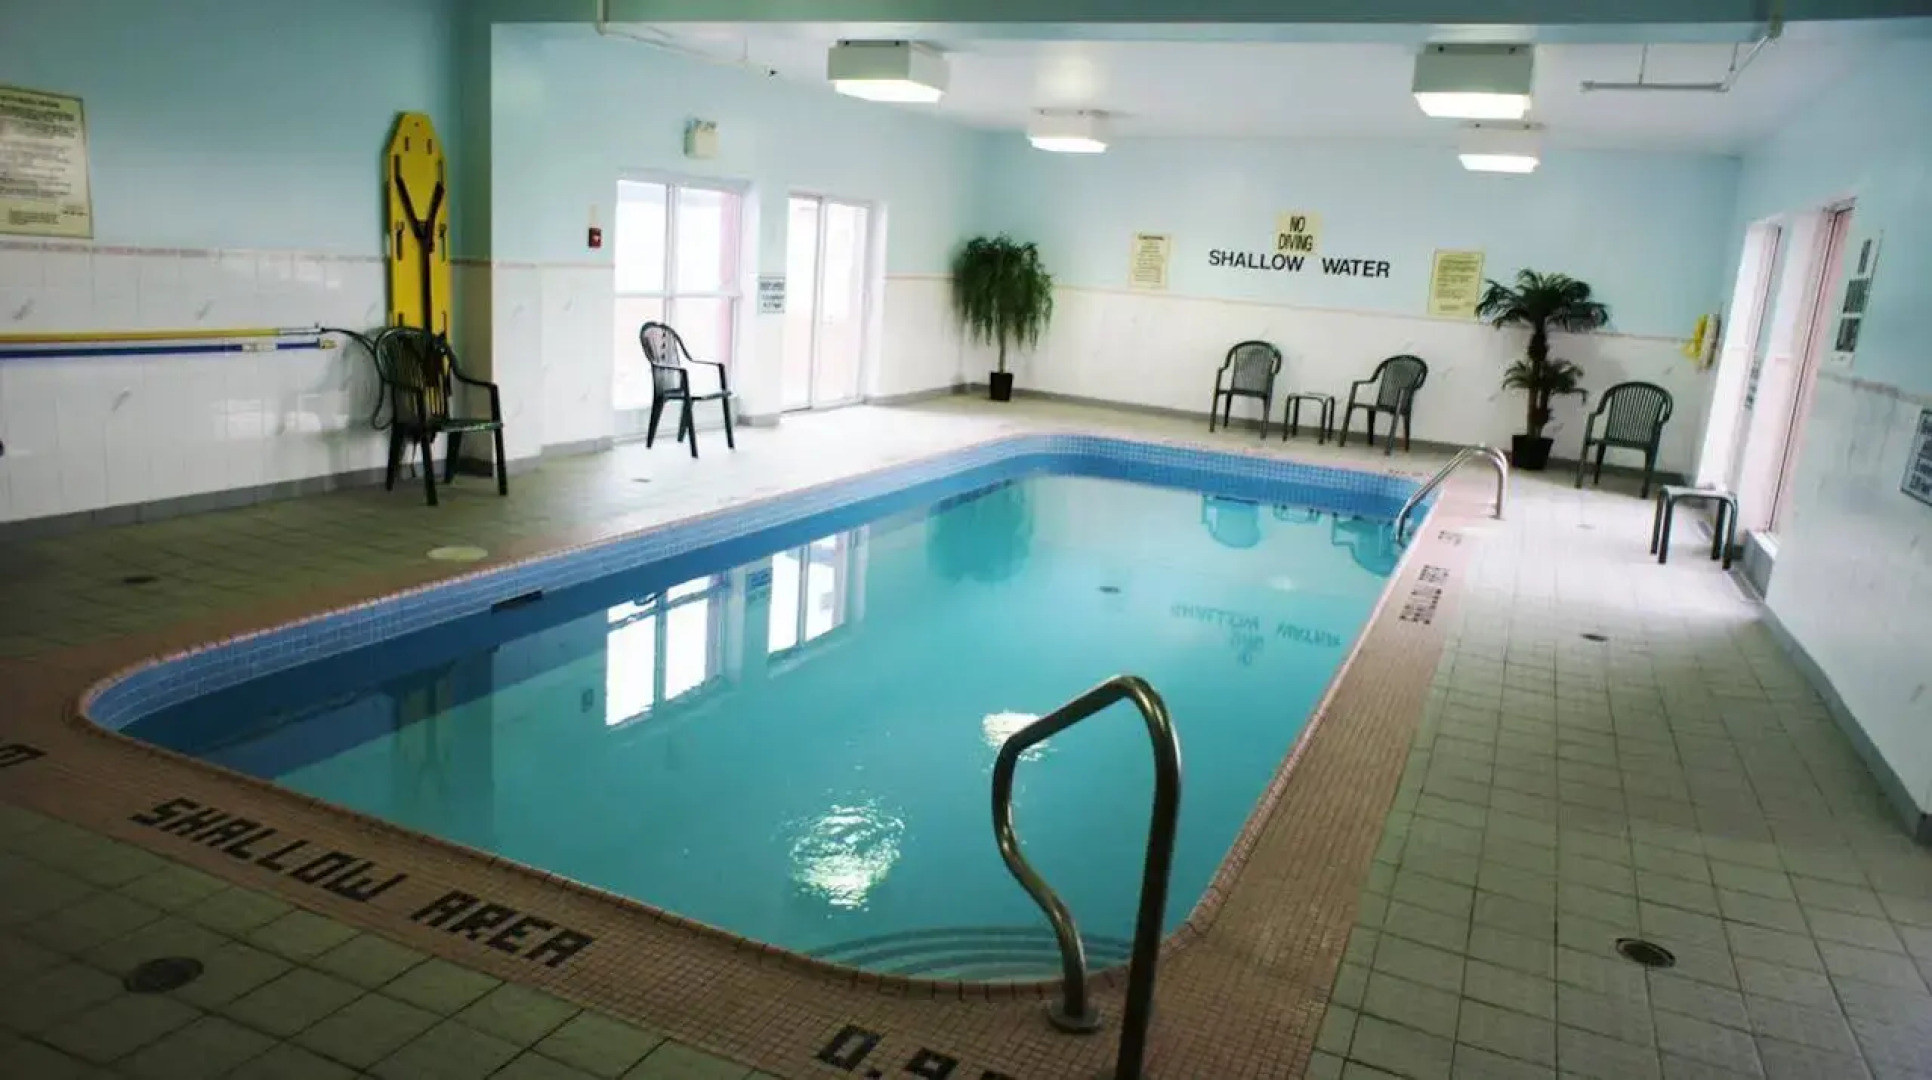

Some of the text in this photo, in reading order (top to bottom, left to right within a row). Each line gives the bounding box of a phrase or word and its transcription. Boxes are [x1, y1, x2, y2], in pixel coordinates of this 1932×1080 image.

[1290, 216, 1306, 232] NO
[1278, 234, 1313, 252] DIVING
[1208, 249, 1391, 278] SHALLOW WATER
[130, 797, 596, 969] SHALLOW AREA
